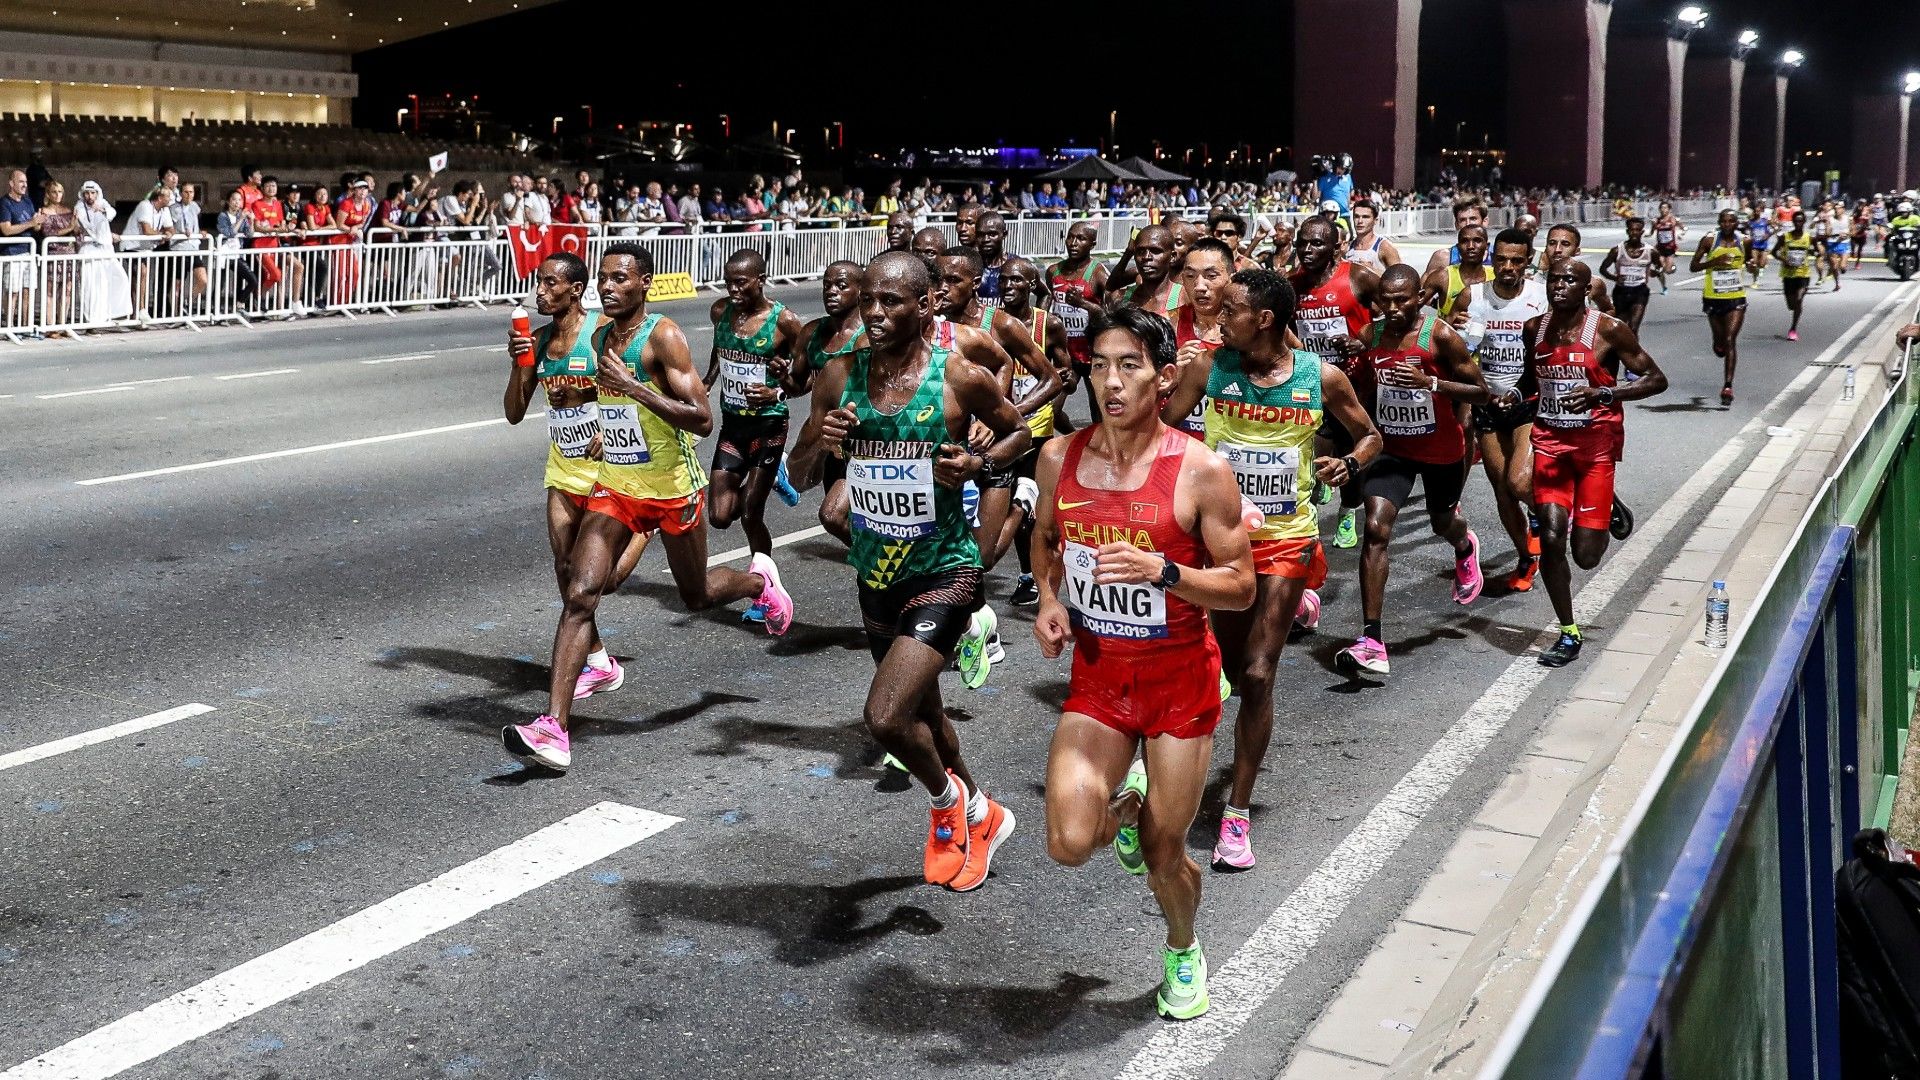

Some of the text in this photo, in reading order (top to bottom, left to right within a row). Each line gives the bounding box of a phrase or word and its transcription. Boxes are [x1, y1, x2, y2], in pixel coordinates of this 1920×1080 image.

[648, 277, 694, 297] SEIKO
[1061, 317, 1084, 328] RUI
[1310, 320, 1338, 331] TDK
[1486, 321, 1524, 330] SUISS
[729, 364, 757, 376] TDK
[1536, 364, 1586, 380] BAHRAIN
[1012, 378, 1030, 388] DK
[1551, 382, 1578, 392] TDK
[1389, 389, 1422, 401] TDK
[558, 407, 588, 420] TDK
[1213, 399, 1316, 426] ETHIOPIA
[1380, 403, 1429, 423] KORIR
[603, 427, 641, 448] SISA
[1384, 426, 1427, 435] DOHA2019
[851, 439, 934, 459] ZIMBABWE
[1240, 451, 1287, 465] TDK
[864, 464, 918, 481] TDK
[1234, 471, 1294, 496] REMEW
[850, 484, 928, 518] NCUBE
[864, 518, 921, 538] DOHA2019
[1063, 521, 1156, 552] CHINA
[1072, 576, 1152, 618] YANG
[1081, 615, 1151, 638] DOHA2019
